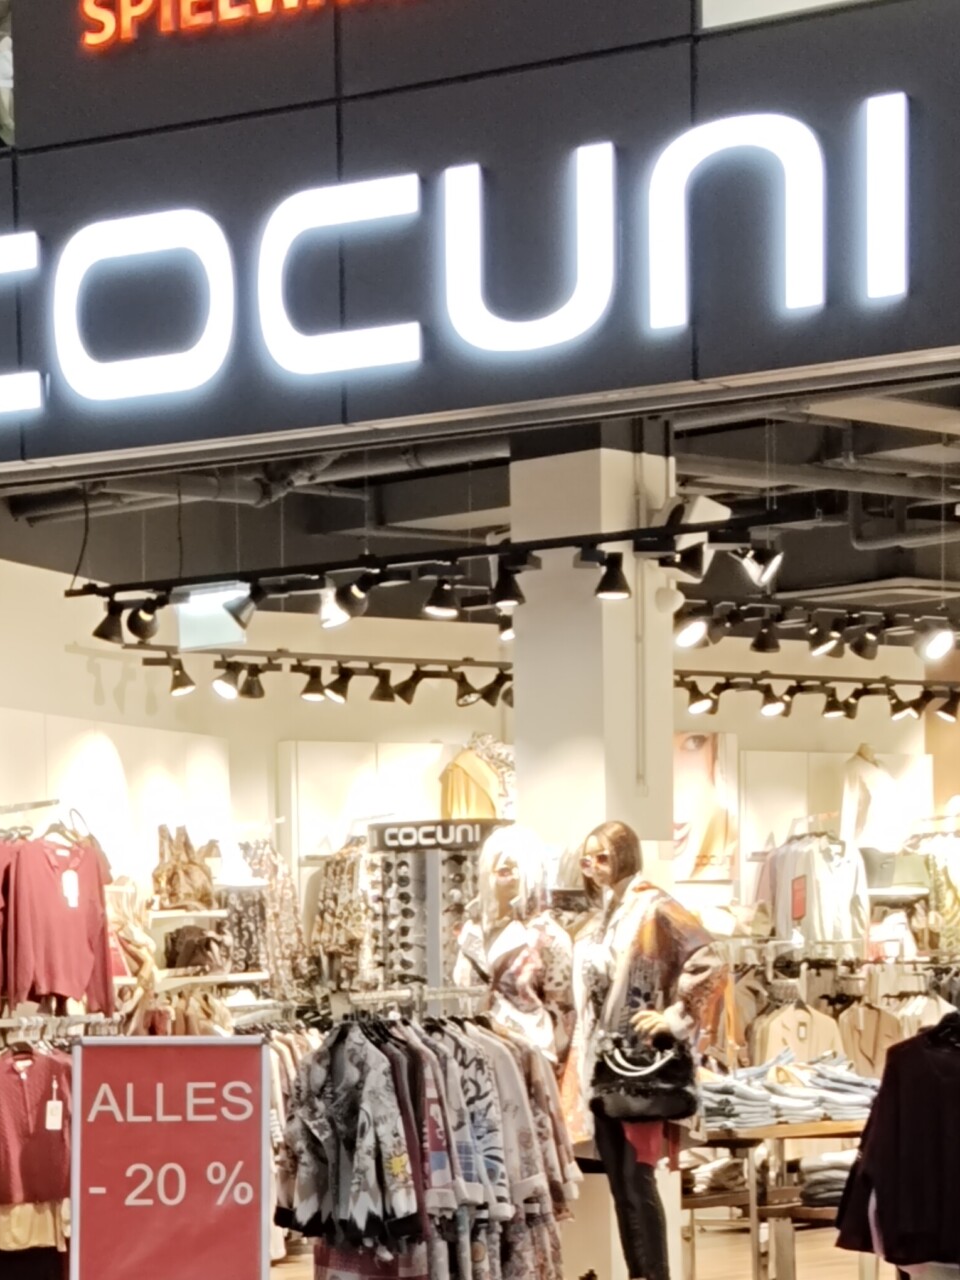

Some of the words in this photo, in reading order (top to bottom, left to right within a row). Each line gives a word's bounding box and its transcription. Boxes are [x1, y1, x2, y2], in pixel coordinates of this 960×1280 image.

[384, 823, 480, 846] COCUNI
[87, 1081, 254, 1122] ALLES
[124, 1162, 187, 1206] 20
[206, 1161, 254, 1205] %
